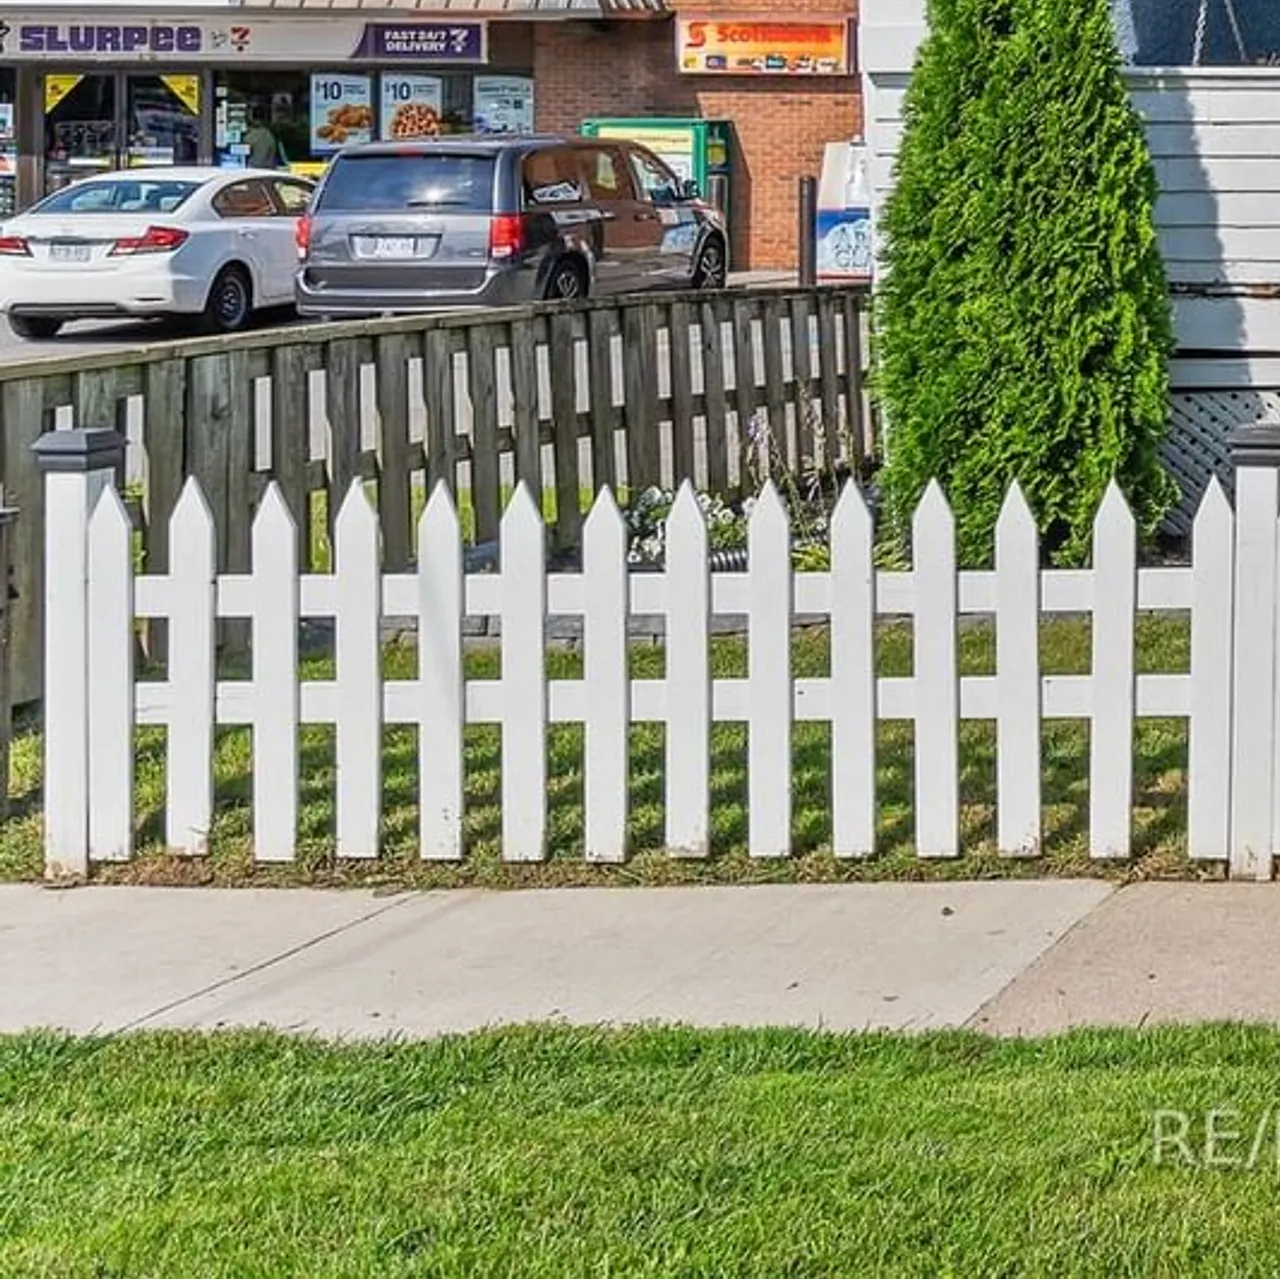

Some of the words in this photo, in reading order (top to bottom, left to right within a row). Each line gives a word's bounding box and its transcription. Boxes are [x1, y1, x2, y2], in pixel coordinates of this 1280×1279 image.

[384, 30, 416, 40] FAST
[716, 23, 832, 42] Scoti
[385, 41, 447, 52] DELIVERY
